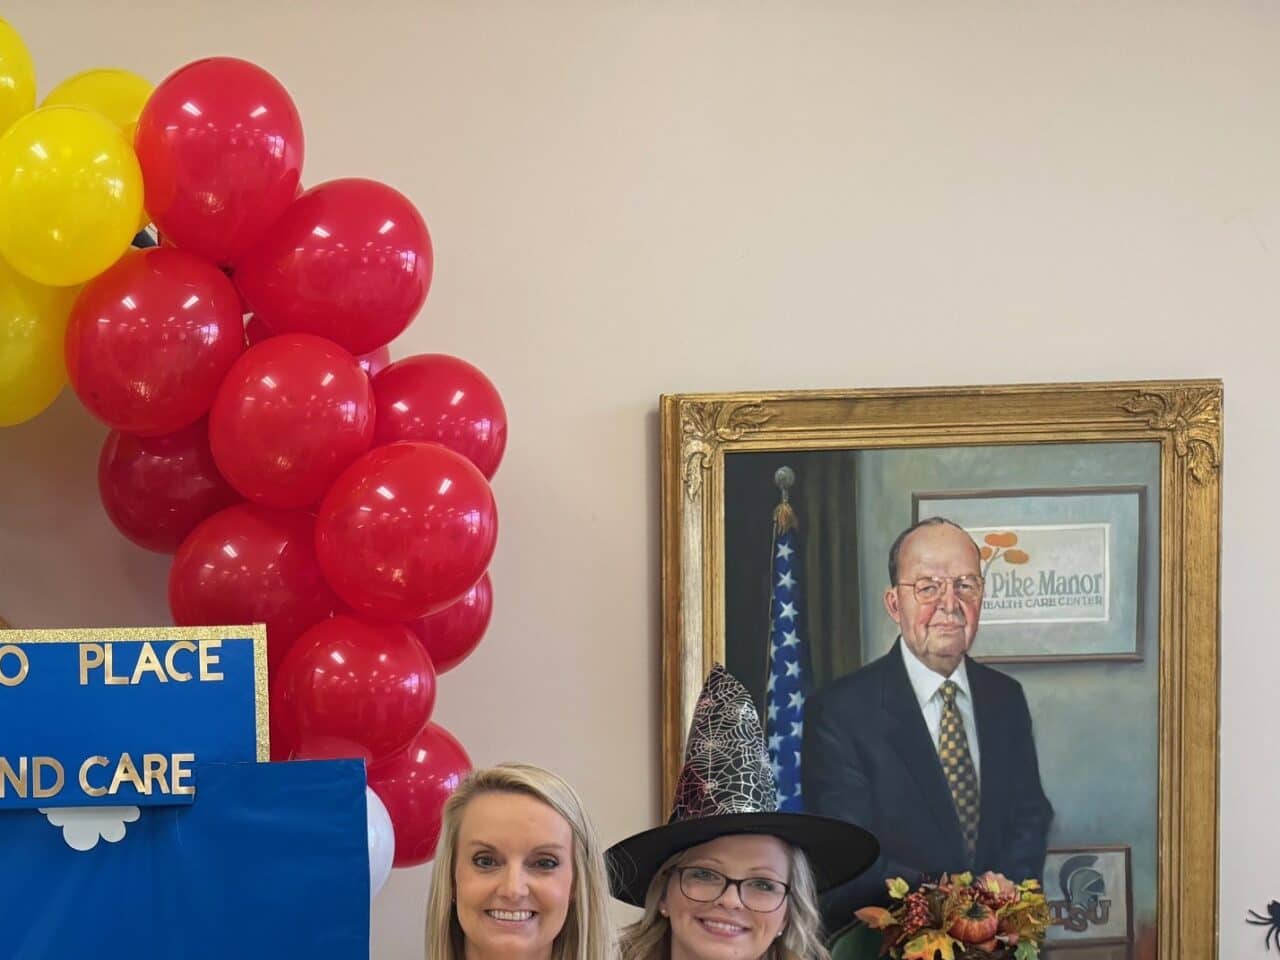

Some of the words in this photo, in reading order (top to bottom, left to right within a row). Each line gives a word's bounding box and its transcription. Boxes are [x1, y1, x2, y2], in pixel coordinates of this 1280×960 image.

[991, 568, 1035, 598] Pike
[1037, 570, 1102, 597] Manor
[1024, 597, 1057, 608] CARE
[1058, 595, 1103, 606] CENTER
[79, 639, 224, 685] PLACE
[78, 752, 196, 800] CARE
[1047, 899, 1112, 933] TSU
